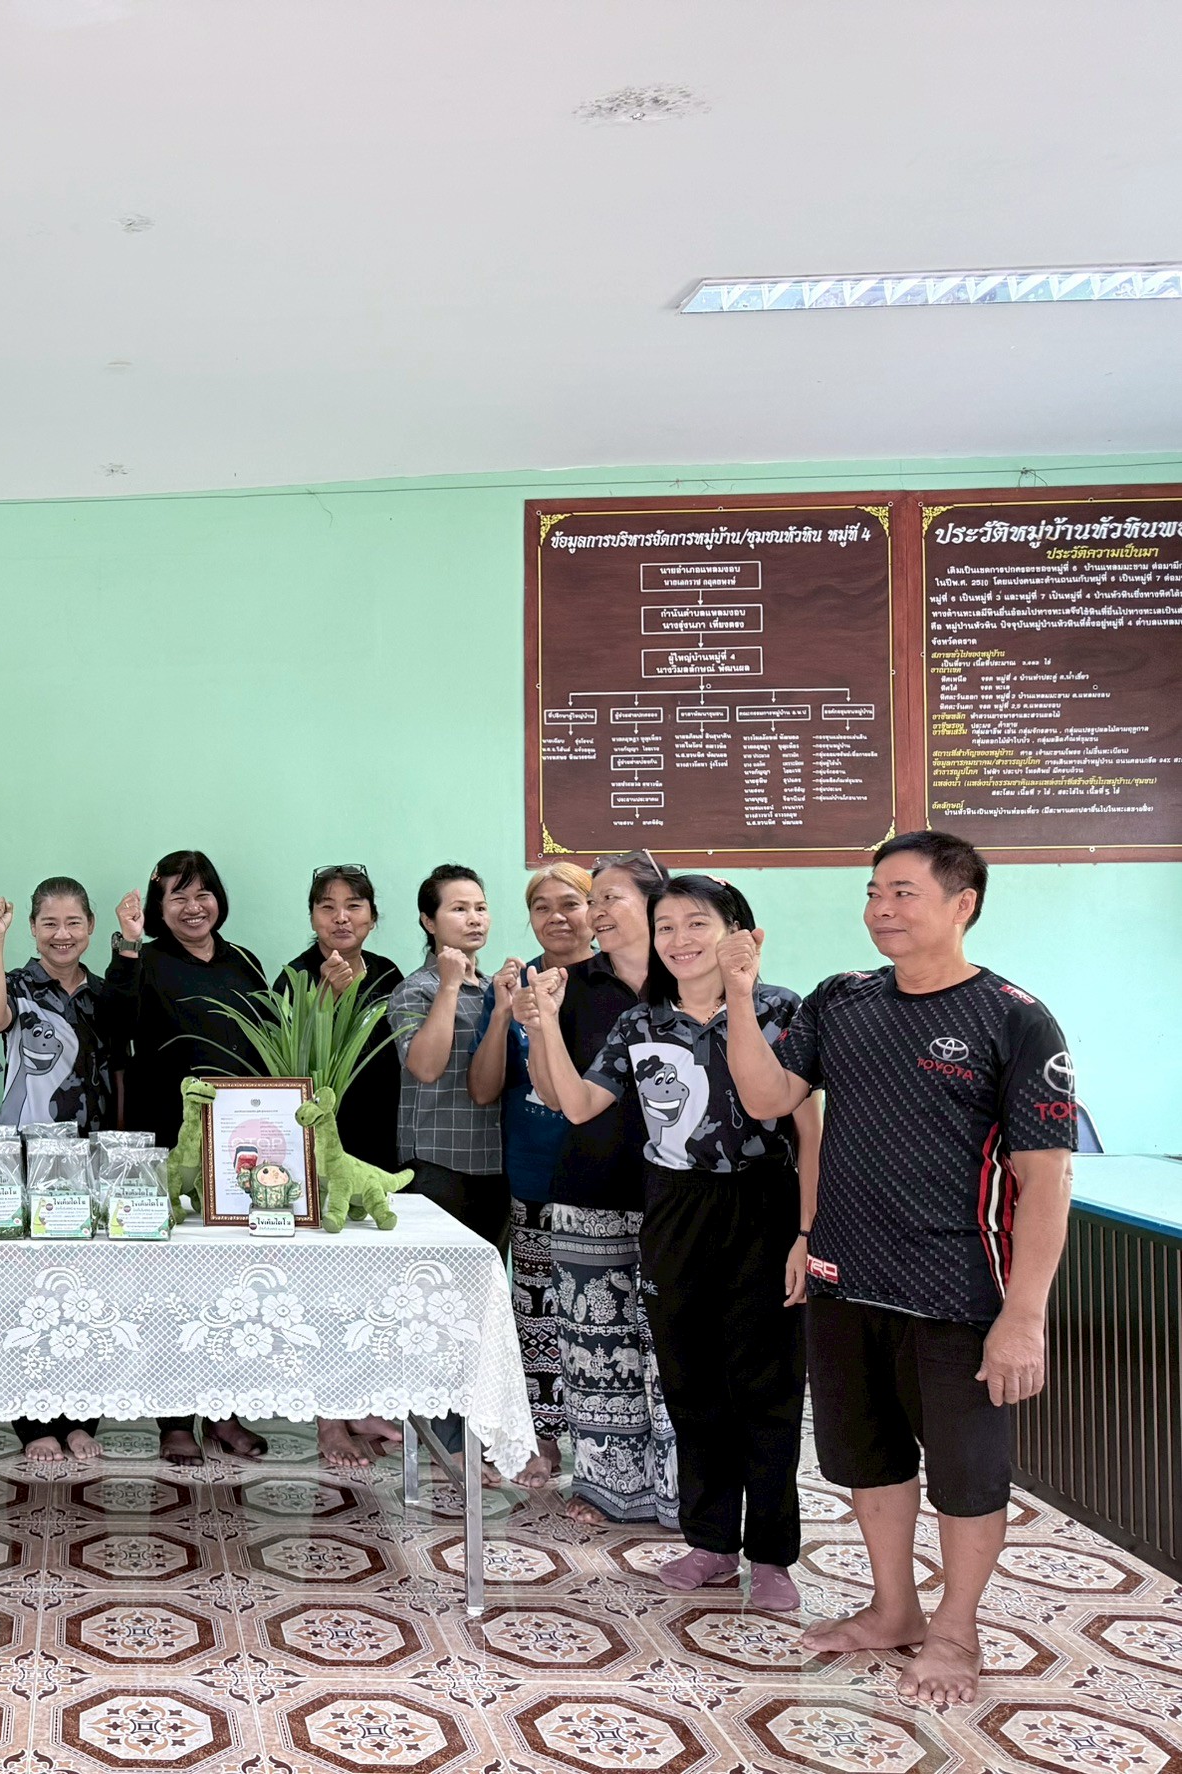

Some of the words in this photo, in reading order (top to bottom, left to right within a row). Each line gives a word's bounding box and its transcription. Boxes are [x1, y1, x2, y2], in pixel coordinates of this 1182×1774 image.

[550, 525, 821, 553] ข้อมูลการบริหารจัดการหมู่บ้าน/ชุมชนหัวหิน
[827, 522, 859, 550] หมู่ที่
[861, 527, 871, 542] 4
[934, 516, 1182, 549] ประวัติหมู่บ้านหัวหินพ
[1046, 543, 1159, 560] ประวัติความเป็นมา
[660, 565, 740, 574] นายอำเภอแหลมงอบ
[929, 592, 948, 605] หมู่ที่
[931, 636, 978, 646] จังหวัดตราด
[668, 650, 727, 665] ผู้ใหญ่บ้านหมู่ที่
[917, 1057, 973, 1081] TOYOTA
[53, 1197, 86, 1206] ไข่เค็มไดโน
[131, 1199, 164, 1207] ไข่เค็มไดโน
[257, 1217, 291, 1227] ไข่เค็มไดโน
